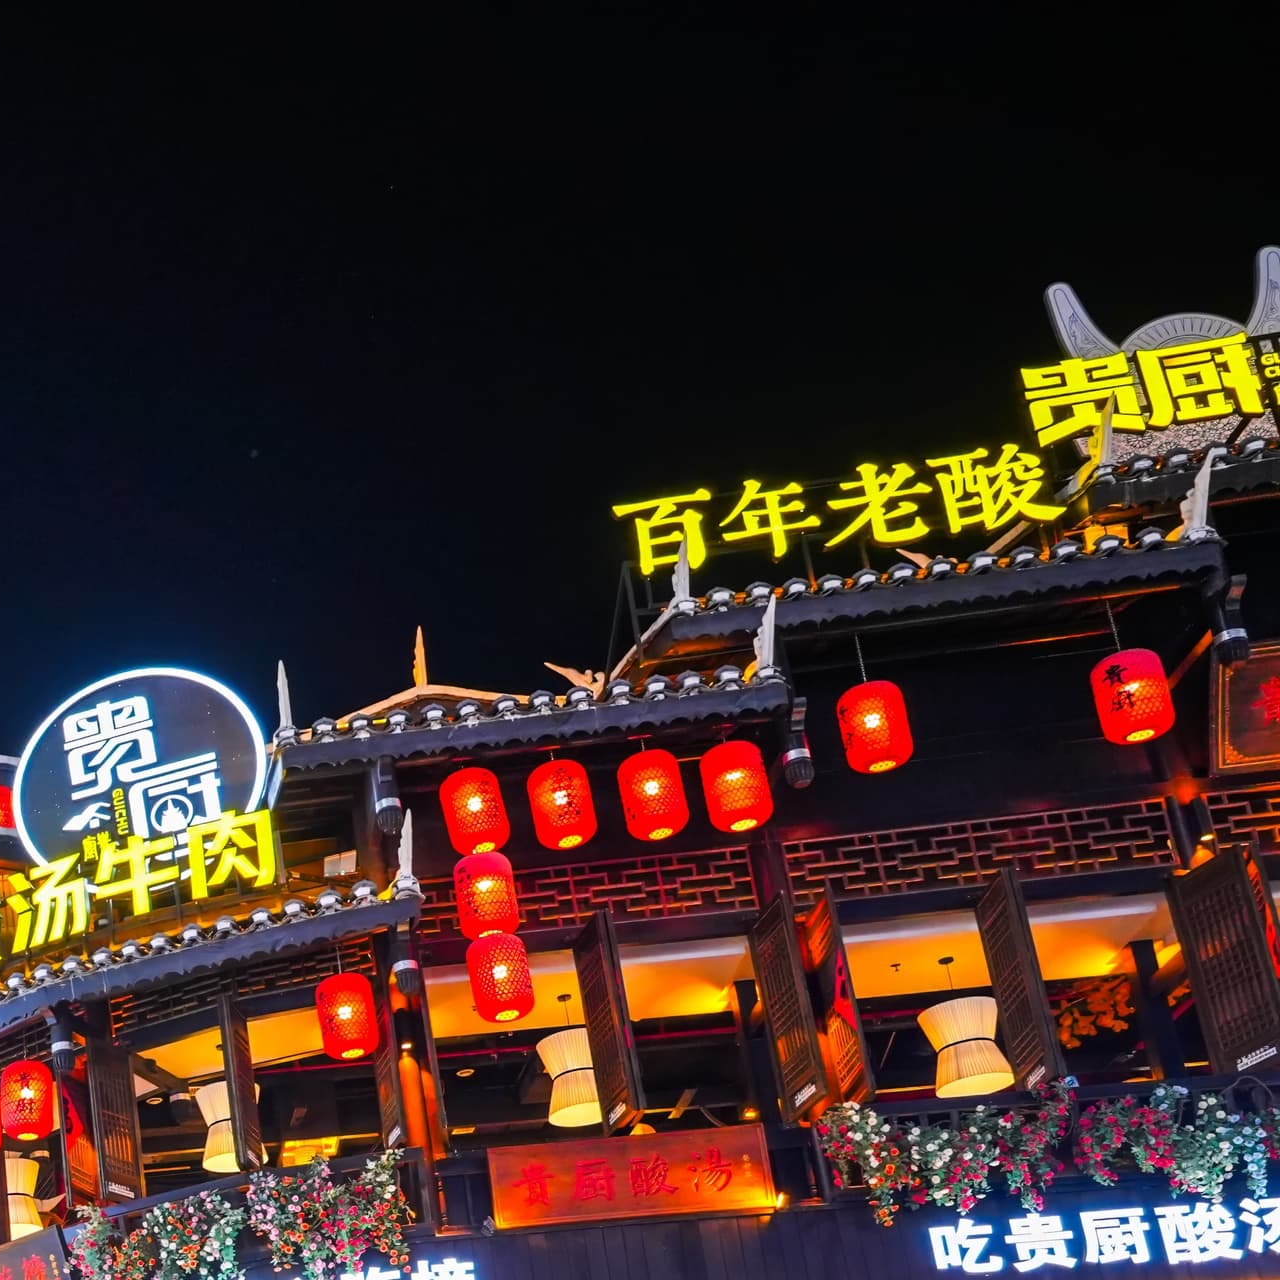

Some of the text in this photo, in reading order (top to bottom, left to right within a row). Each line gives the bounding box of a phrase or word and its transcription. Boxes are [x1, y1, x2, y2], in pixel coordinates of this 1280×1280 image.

[1021, 333, 1264, 447] 贵厨
[612, 443, 1068, 576] 百年老酸
[112, 787, 129, 836] GUICHU
[514, 1150, 733, 1208] 贵厨酸汤
